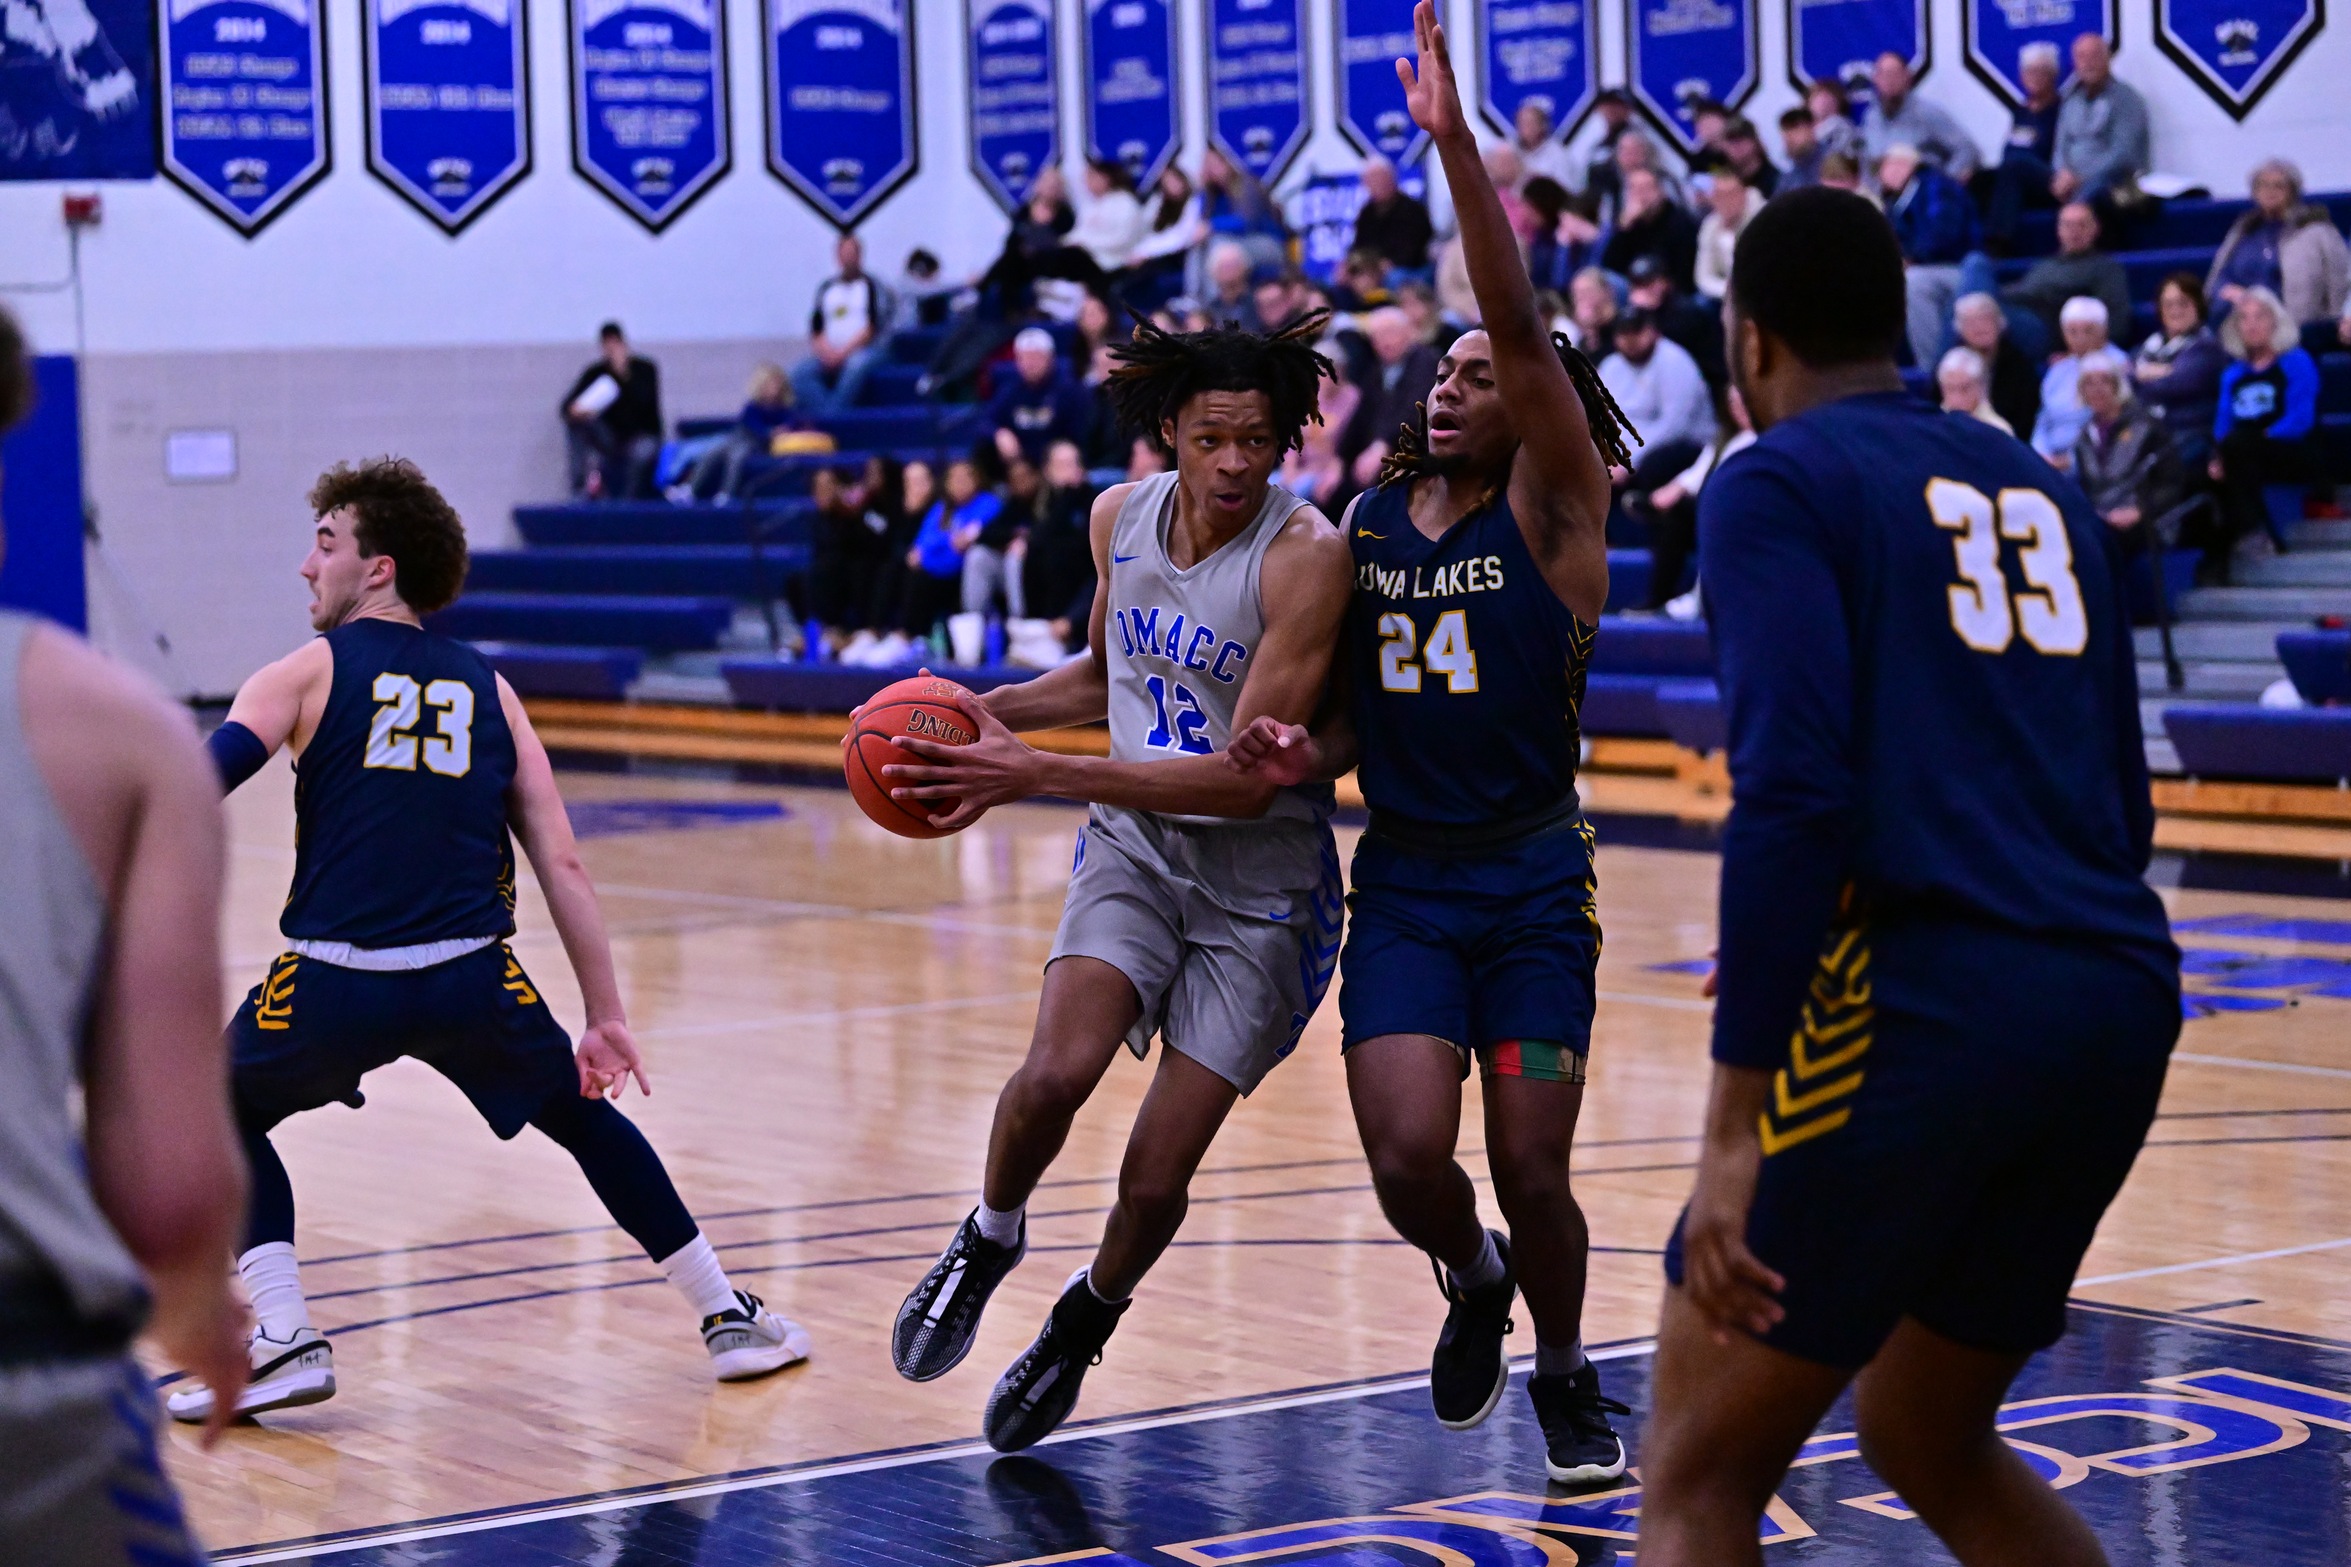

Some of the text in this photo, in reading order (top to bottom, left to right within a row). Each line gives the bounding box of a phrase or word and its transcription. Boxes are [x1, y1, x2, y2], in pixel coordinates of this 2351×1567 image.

[1355, 555, 1504, 600] OWA LAKES
[1924, 475, 2089, 657] 33
[1378, 609, 1479, 694] 24
[363, 672, 475, 778] 23
[906, 708, 976, 746] LDING
[1144, 673, 1216, 755] 12
